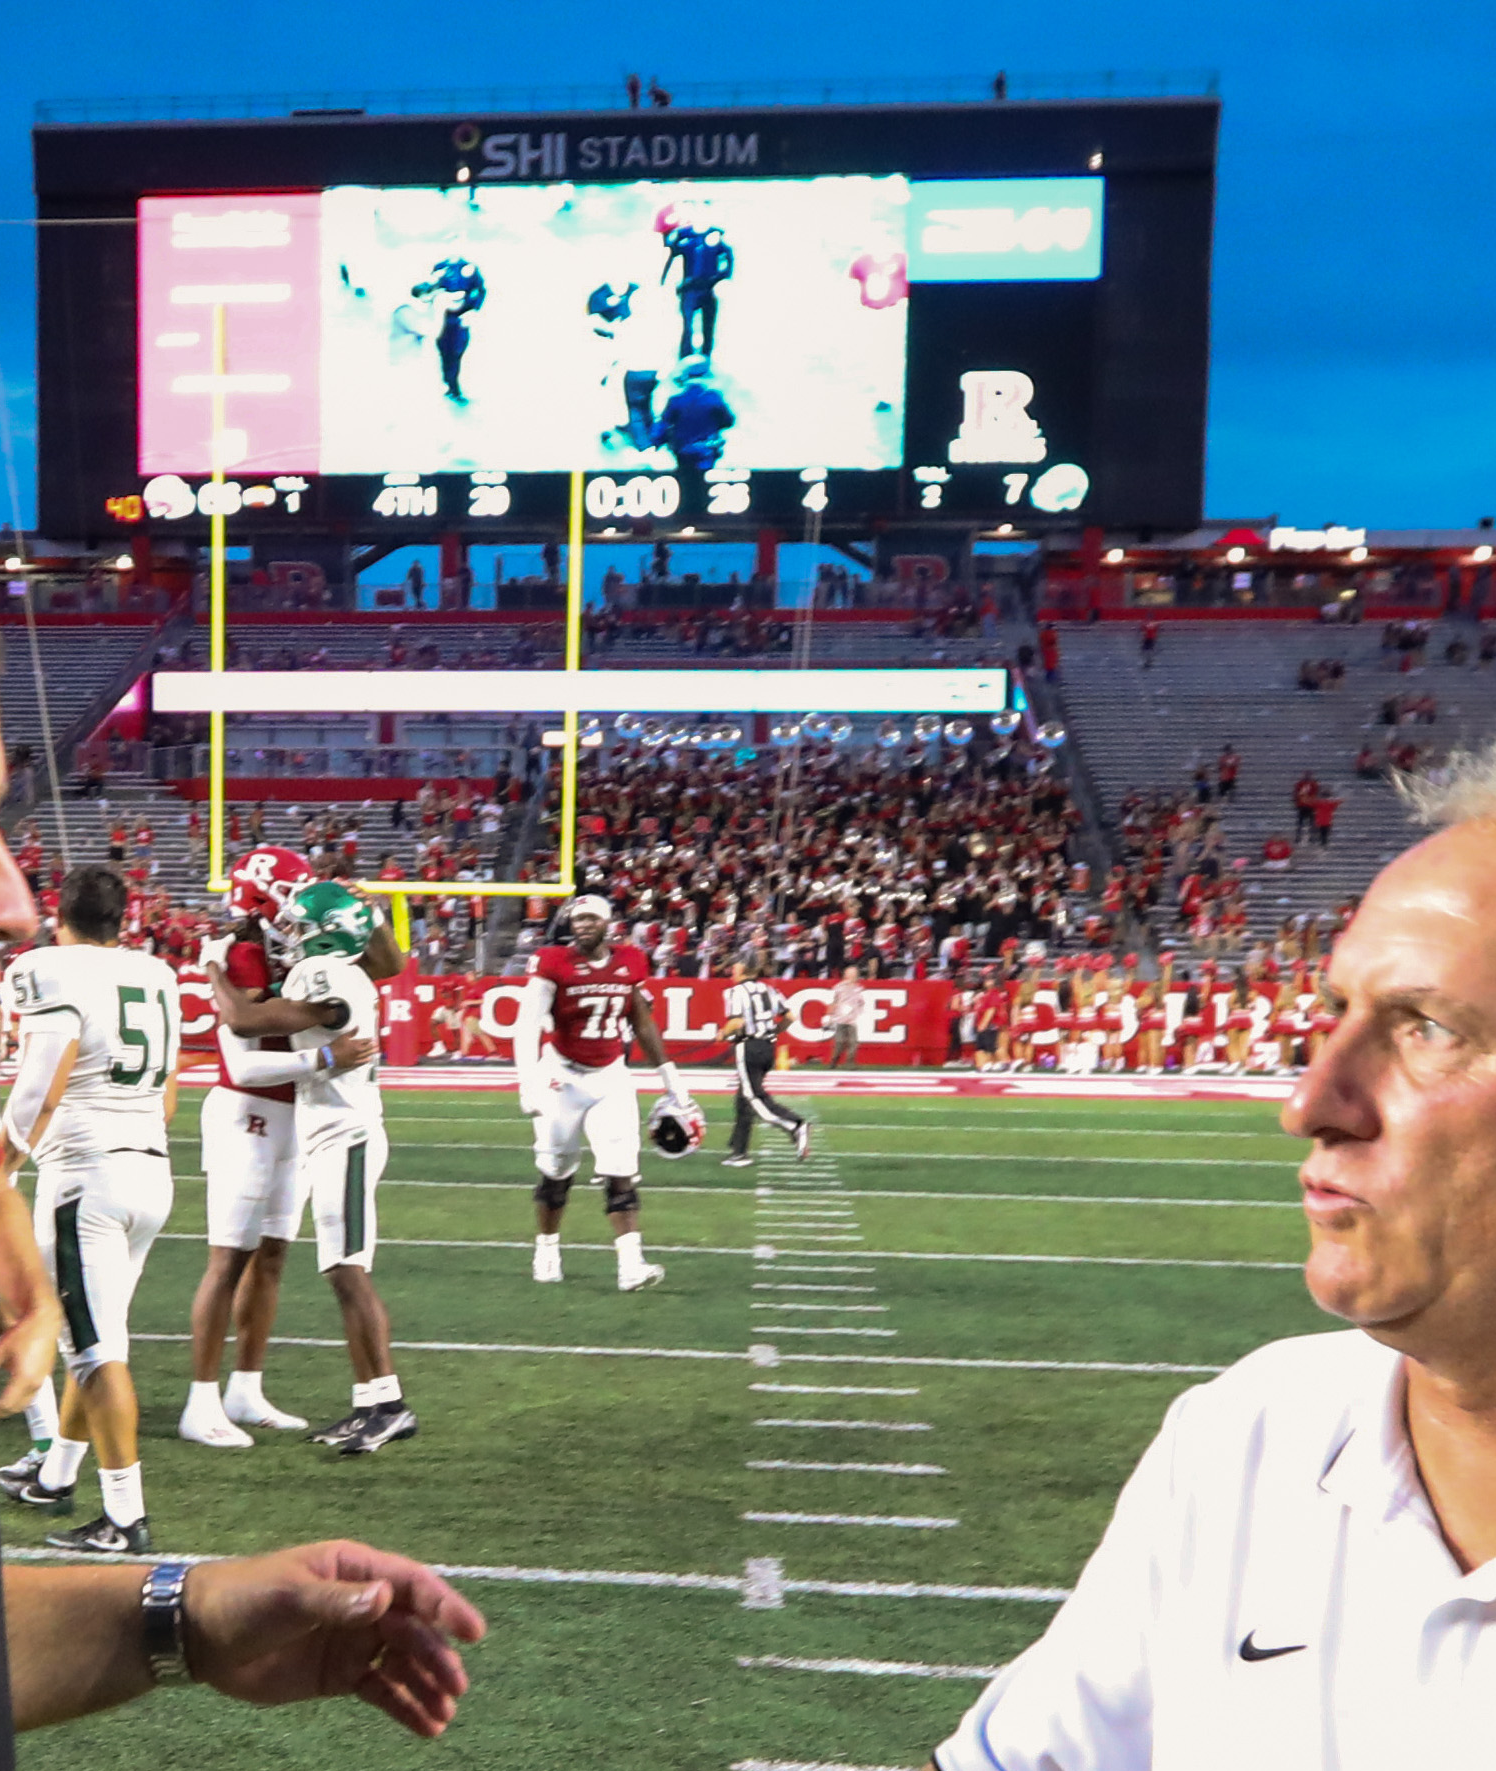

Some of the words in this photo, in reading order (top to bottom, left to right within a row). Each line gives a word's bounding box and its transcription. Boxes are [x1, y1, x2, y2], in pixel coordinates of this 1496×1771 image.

[478, 132, 568, 178] SHI
[578, 132, 760, 169] STADIUM
[372, 486, 438, 517] 4TH
[585, 475, 680, 518] 0:00
[802, 482, 829, 512] 4
[1003, 473, 1029, 504] 7
[245, 853, 278, 882] R
[11, 969, 44, 1006] 51
[388, 1000, 412, 1021] R
[576, 996, 627, 1039] 71
[110, 983, 170, 1088] 51
[245, 1113, 269, 1137] R
